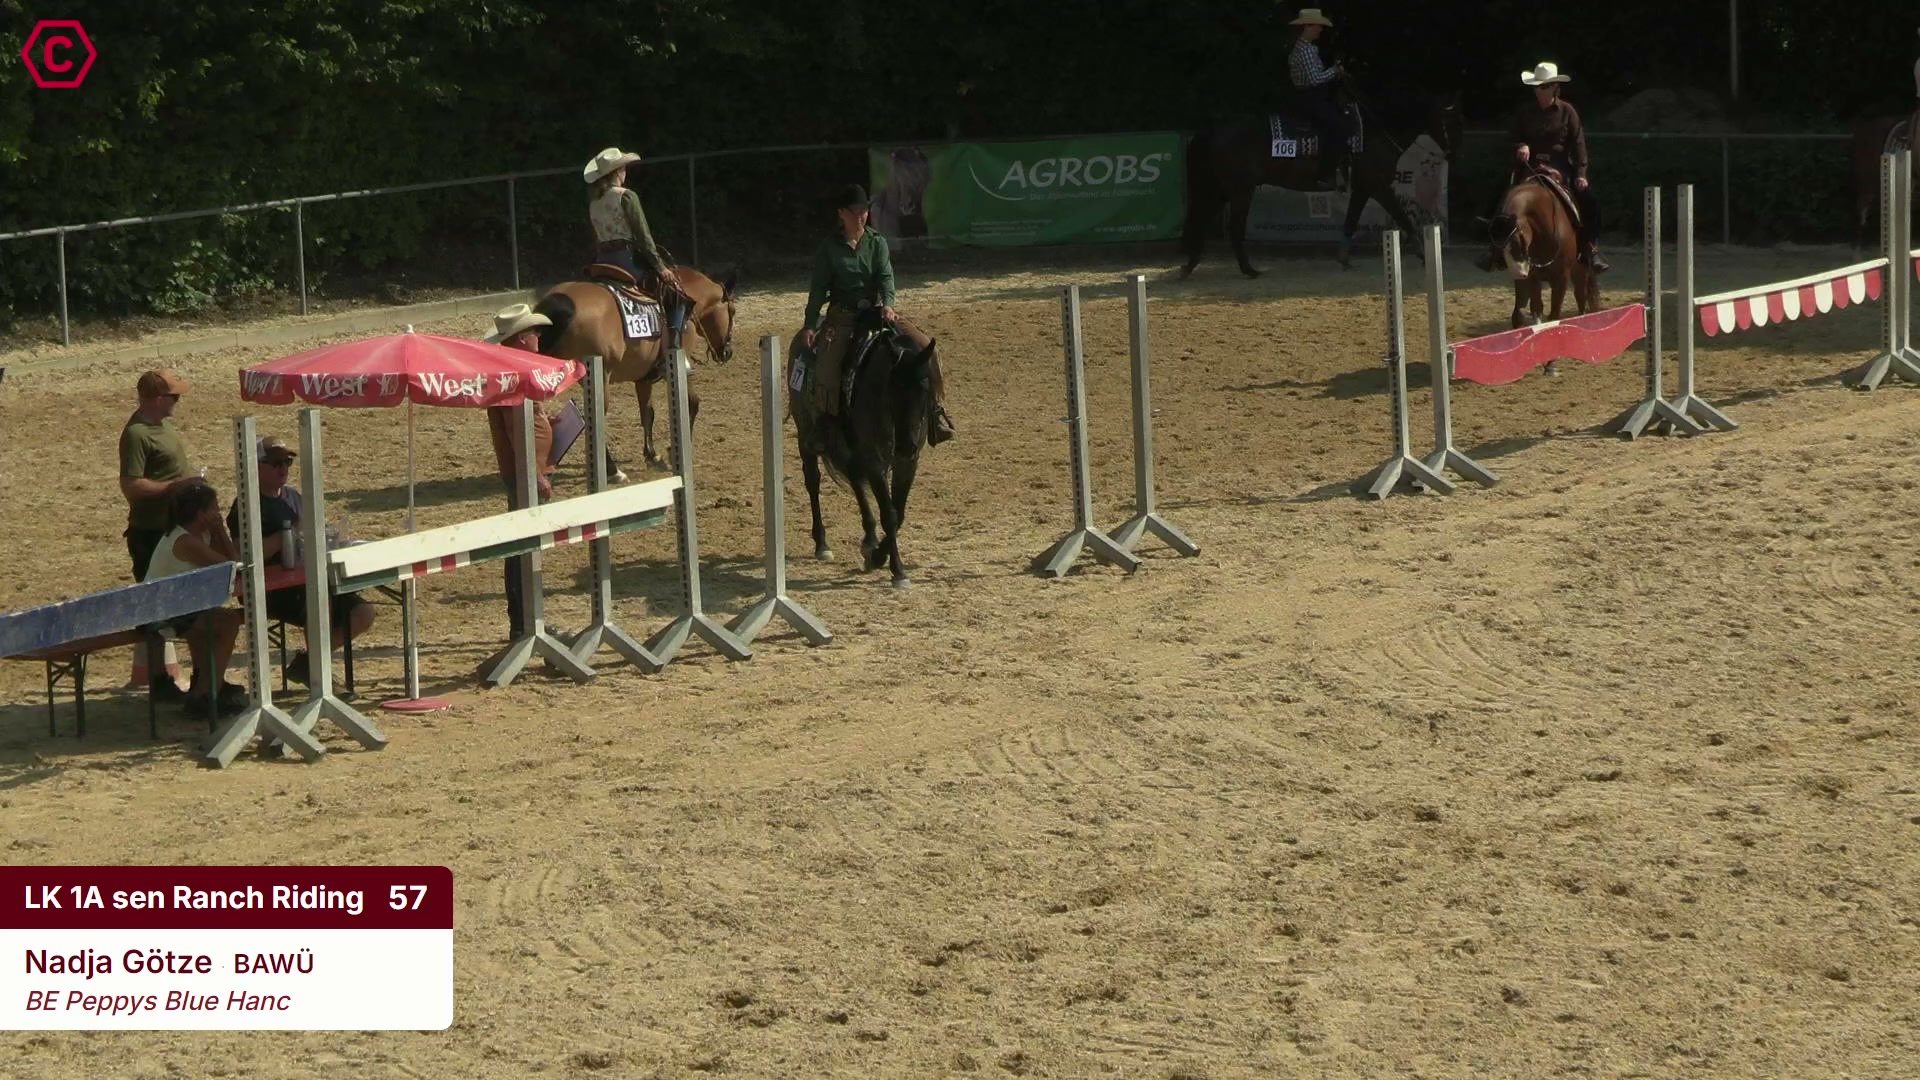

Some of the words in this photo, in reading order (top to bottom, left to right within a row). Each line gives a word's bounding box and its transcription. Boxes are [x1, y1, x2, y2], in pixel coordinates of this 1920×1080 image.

[1274, 143, 1294, 155] 106
[629, 319, 648, 334] 133
[301, 373, 367, 397] West
[417, 372, 487, 397] West
